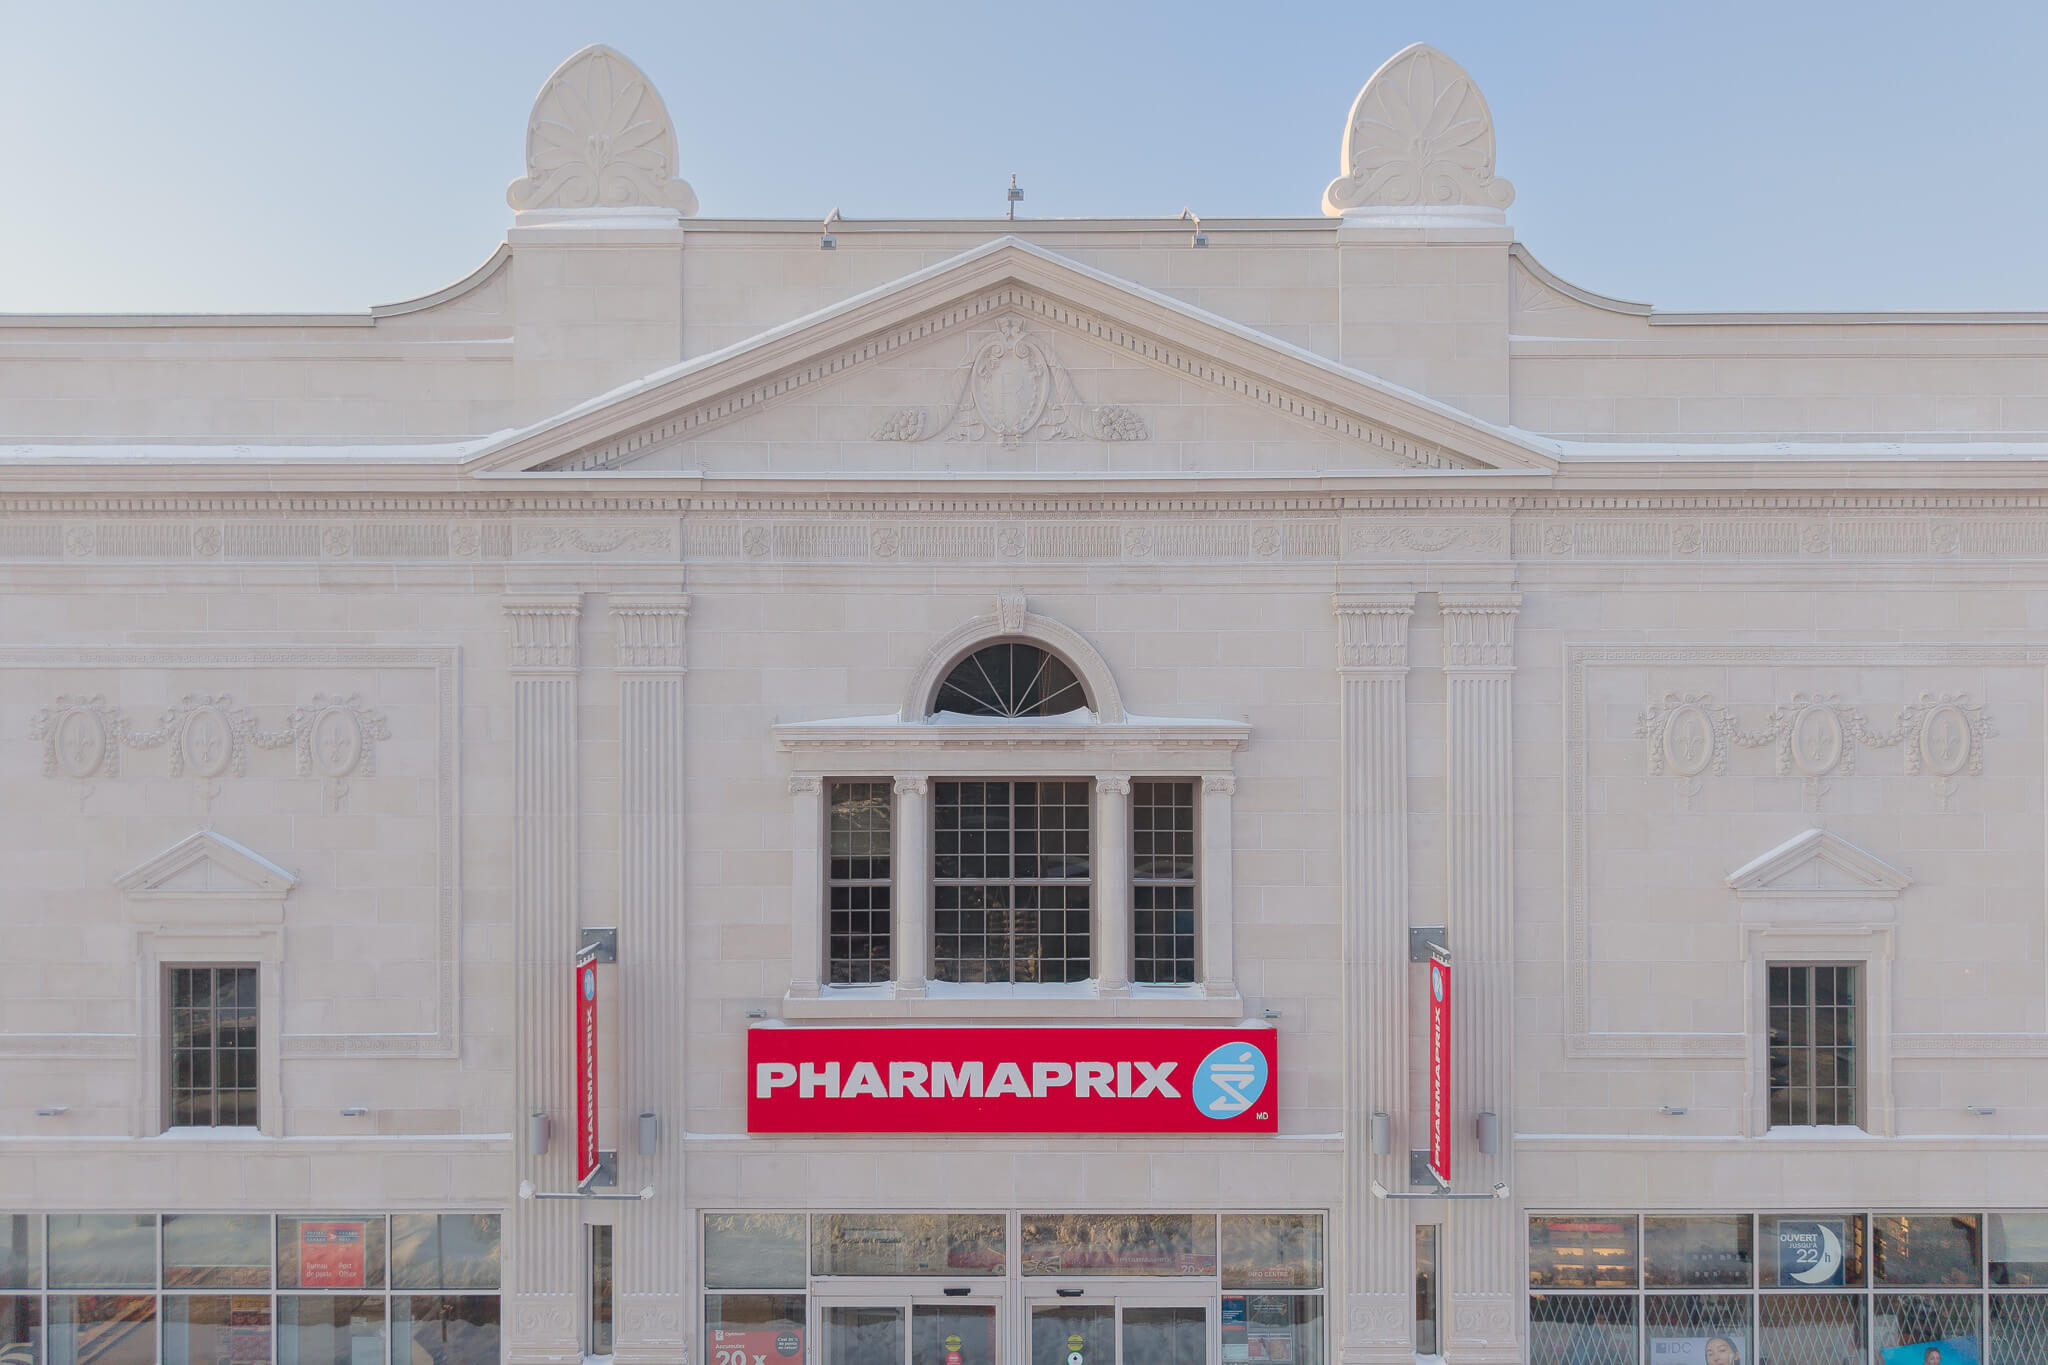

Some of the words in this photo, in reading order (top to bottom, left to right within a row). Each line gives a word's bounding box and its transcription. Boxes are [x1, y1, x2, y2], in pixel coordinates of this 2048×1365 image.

[756, 1061, 1181, 1099] PHARMAPRIX
[1256, 1112, 1269, 1120] MD
[1780, 1233, 1818, 1242] OUVERT
[1796, 1248, 1818, 1263] 22
[339, 1262, 352, 1270] Post
[715, 1350, 747, 1365] 20
